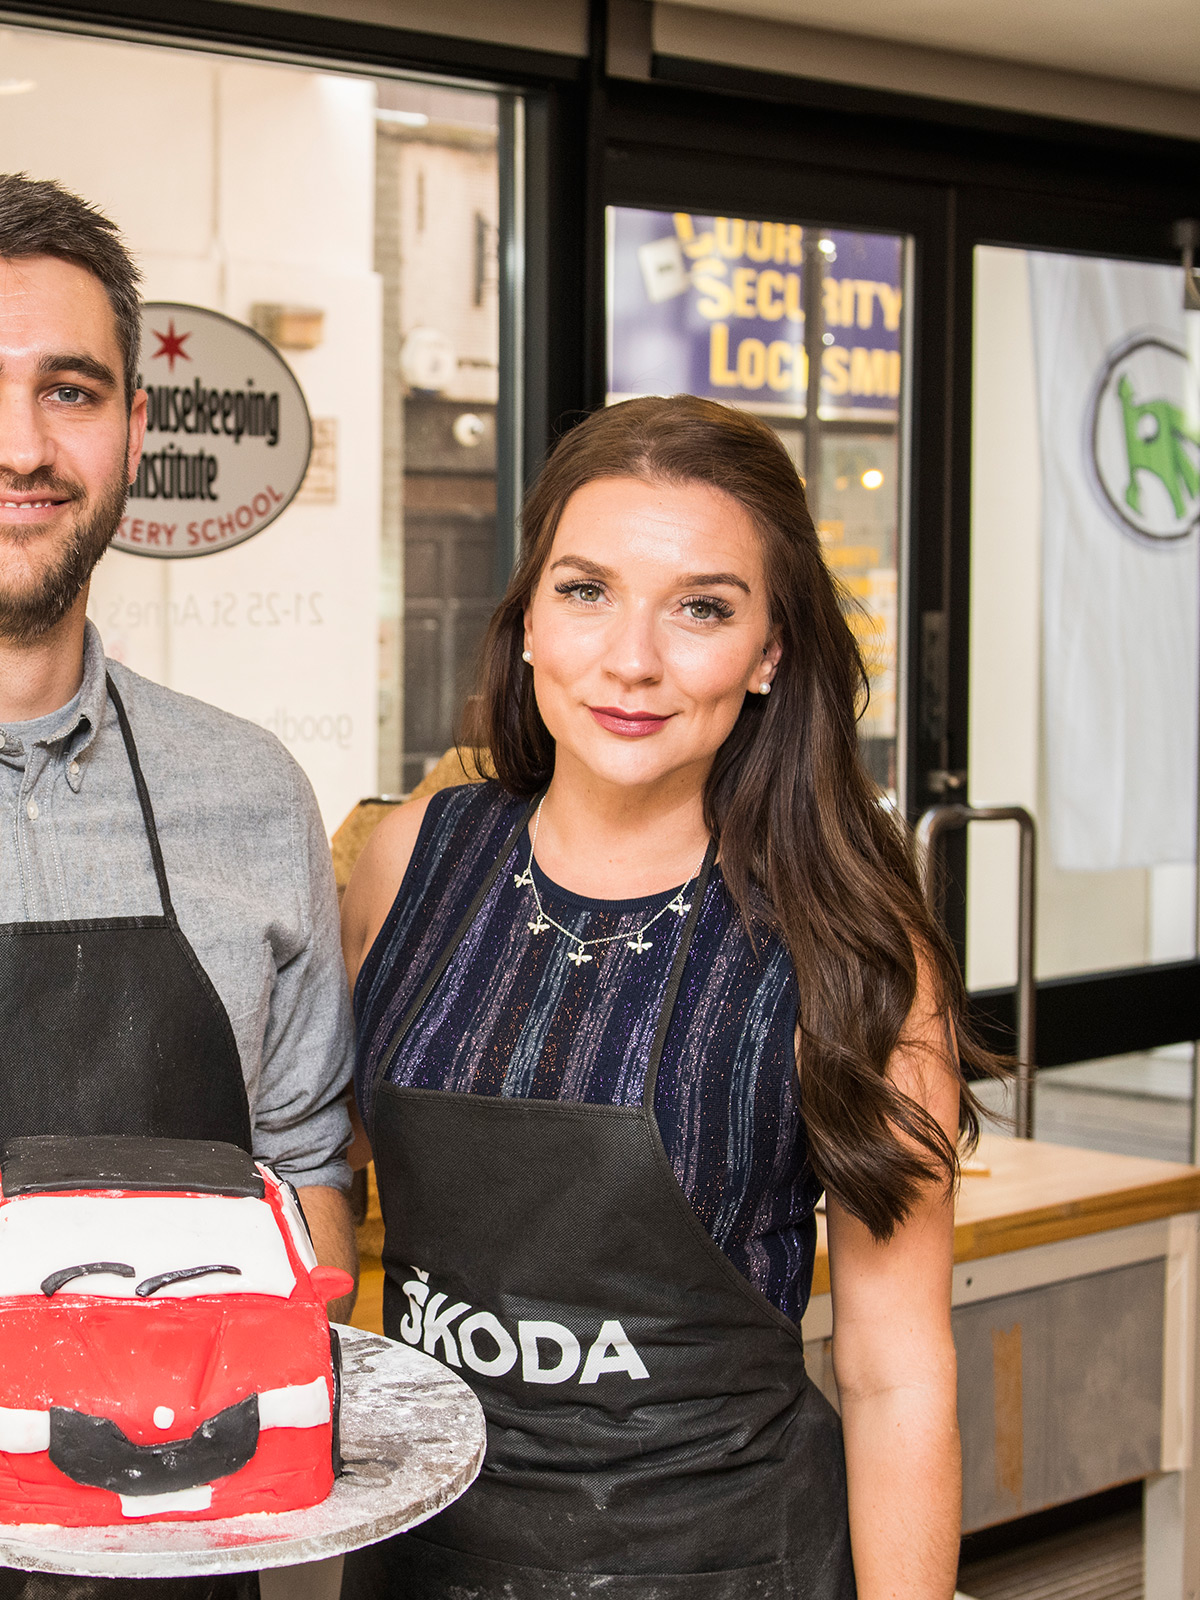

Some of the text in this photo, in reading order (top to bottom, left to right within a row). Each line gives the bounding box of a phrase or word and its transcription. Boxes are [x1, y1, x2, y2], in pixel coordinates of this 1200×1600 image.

[136, 373, 280, 447] ousekeeping
[128, 442, 219, 500] nstitute
[117, 484, 286, 547] KERY SCHOOL
[400, 1265, 650, 1384] ŠKODA
